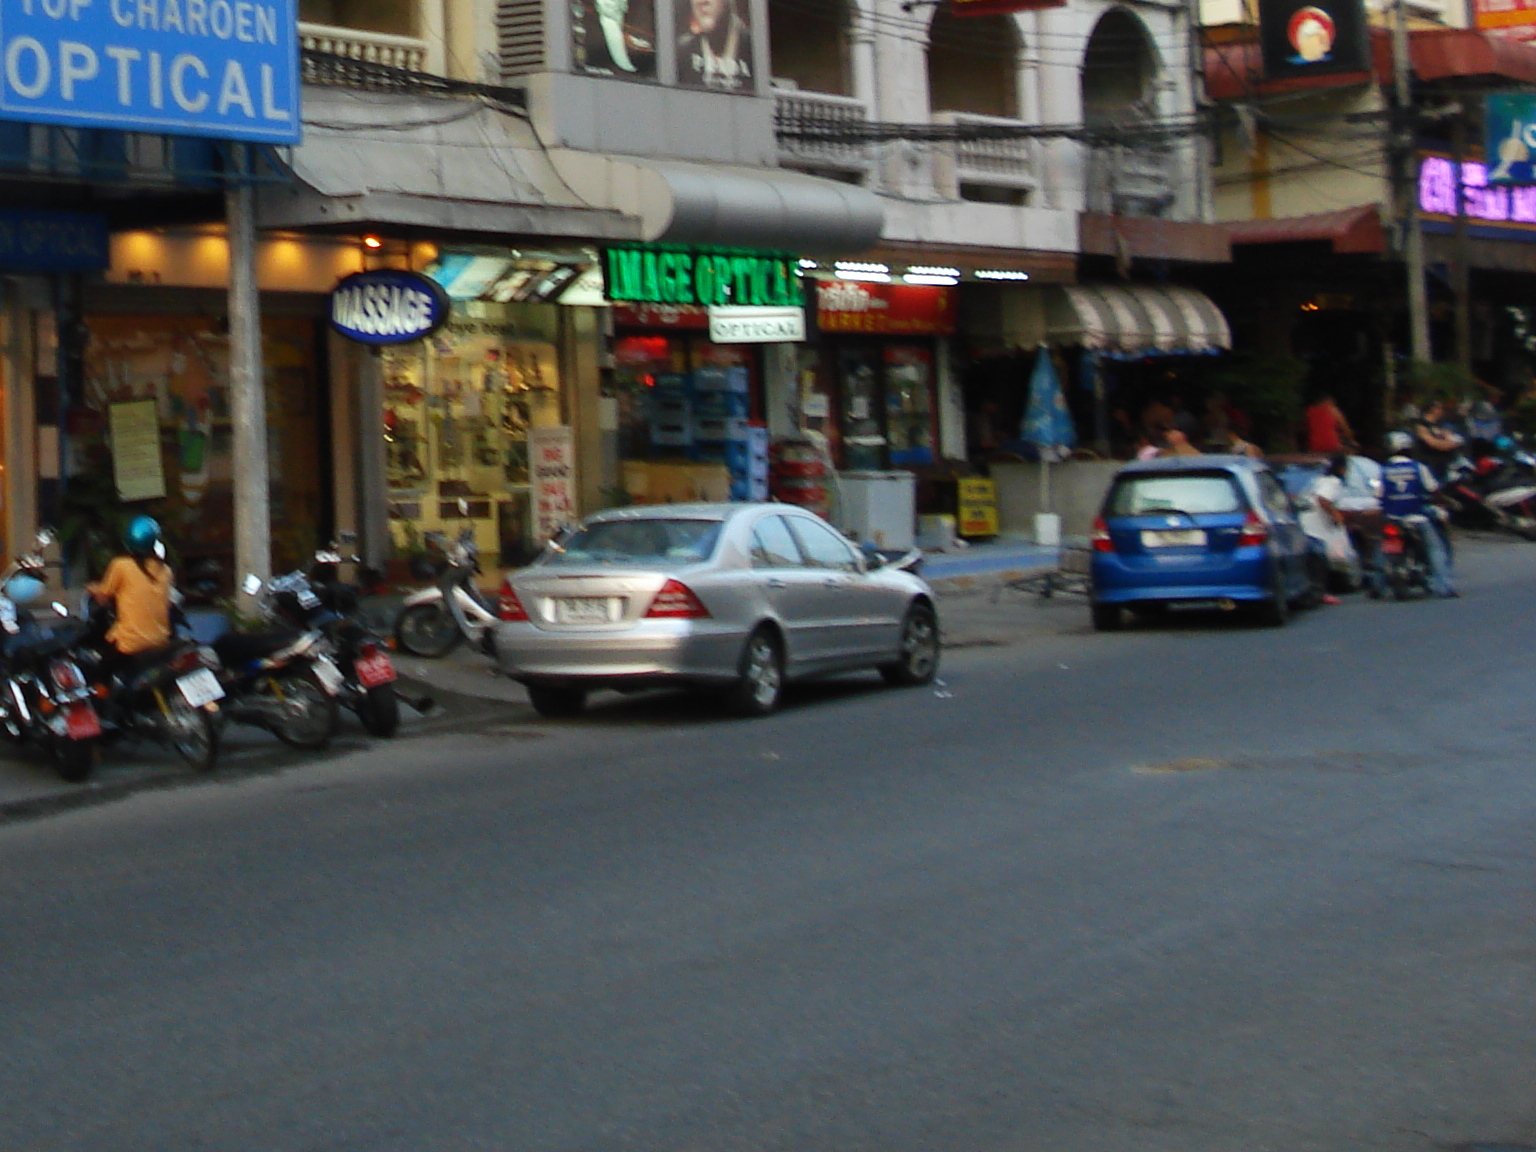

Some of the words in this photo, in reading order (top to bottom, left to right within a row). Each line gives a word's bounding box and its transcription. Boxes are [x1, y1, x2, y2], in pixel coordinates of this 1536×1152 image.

[5, 35, 291, 121] OPTICAL
[607, 248, 695, 303] IMAGE
[695, 254, 806, 305] OPTICAL
[332, 284, 434, 336] MASSAGE
[714, 321, 800, 337] OPTICAL
